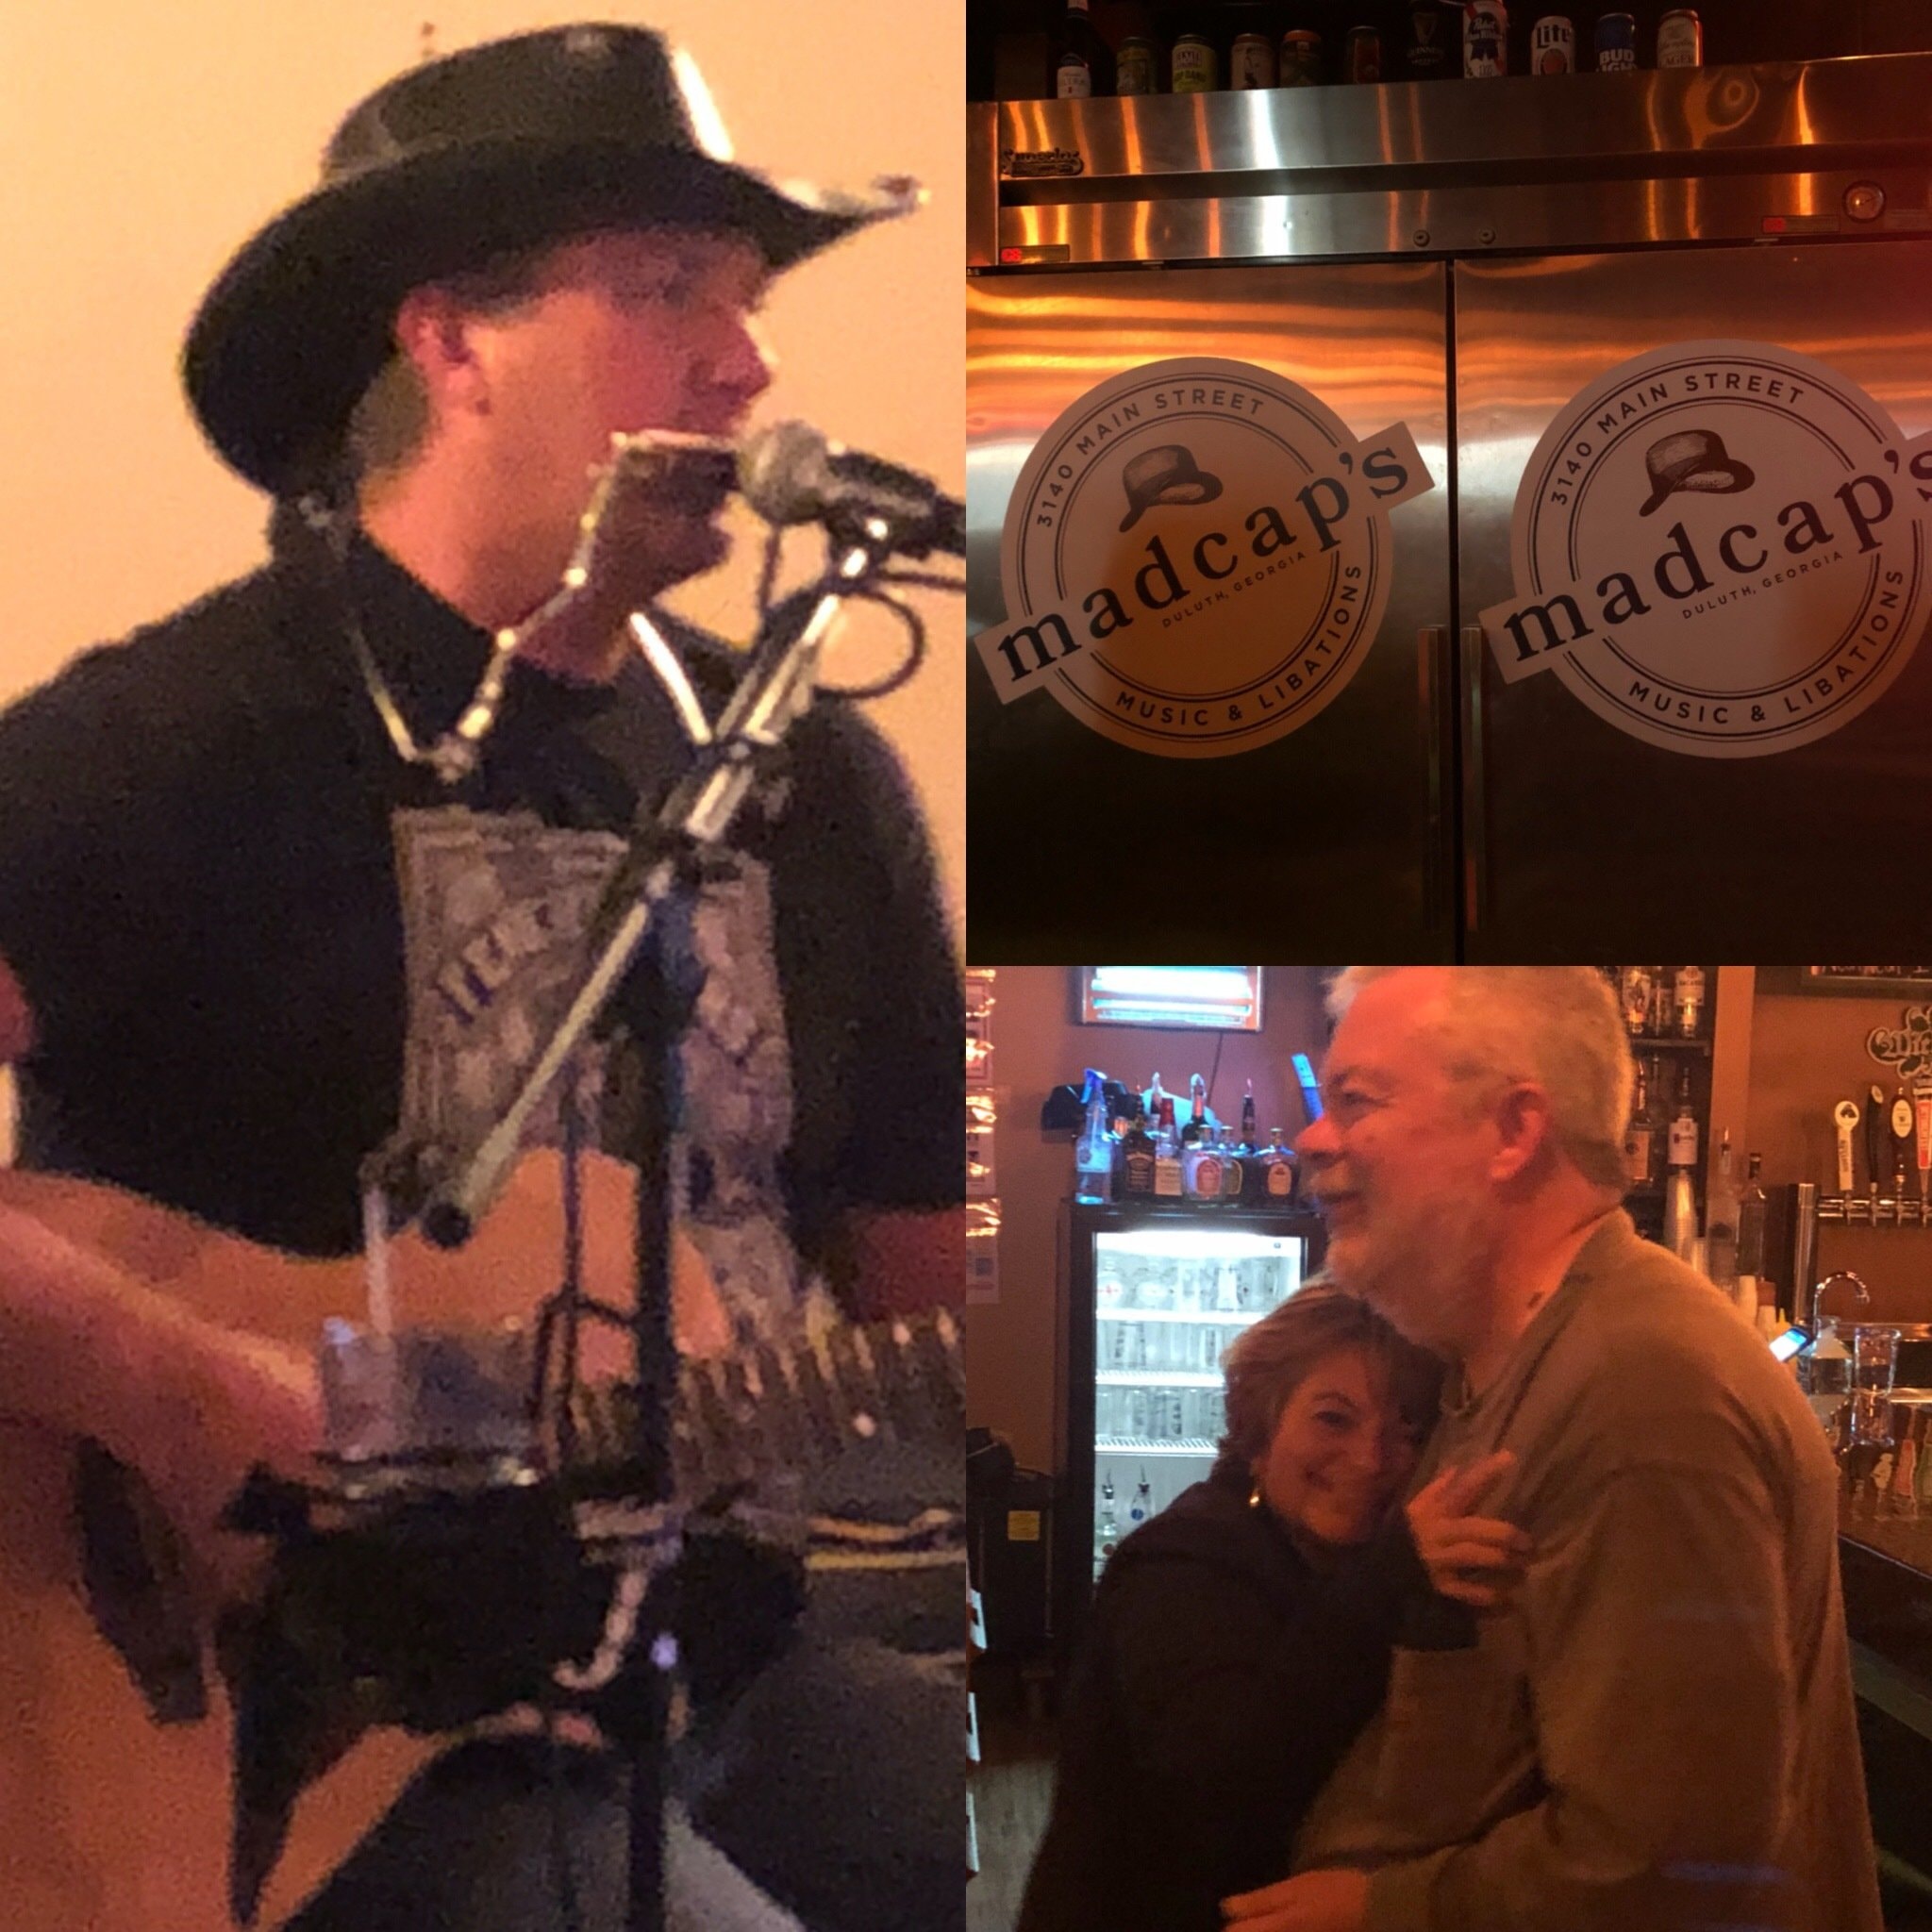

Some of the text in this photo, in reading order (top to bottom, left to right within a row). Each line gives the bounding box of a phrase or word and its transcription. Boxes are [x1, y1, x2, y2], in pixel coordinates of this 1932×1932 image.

[1536, 25, 1571, 48] Lite
[1596, 62, 1639, 72] IGH
[1599, 48, 1636, 63] BUD
[1038, 390, 1264, 527] 3140 MAIN STREET
[1552, 373, 1805, 506] 3140 MAIN STREET
[997, 447, 1408, 682] madcap's
[1162, 552, 1307, 628] DULUTH, GEORGIA
[1683, 552, 1843, 619] DULUTH, GEORGIA
[1117, 566, 1361, 726] MUSIC & LIBATIONS
[1628, 570, 1903, 724] MUSIC & LIBATIONS
